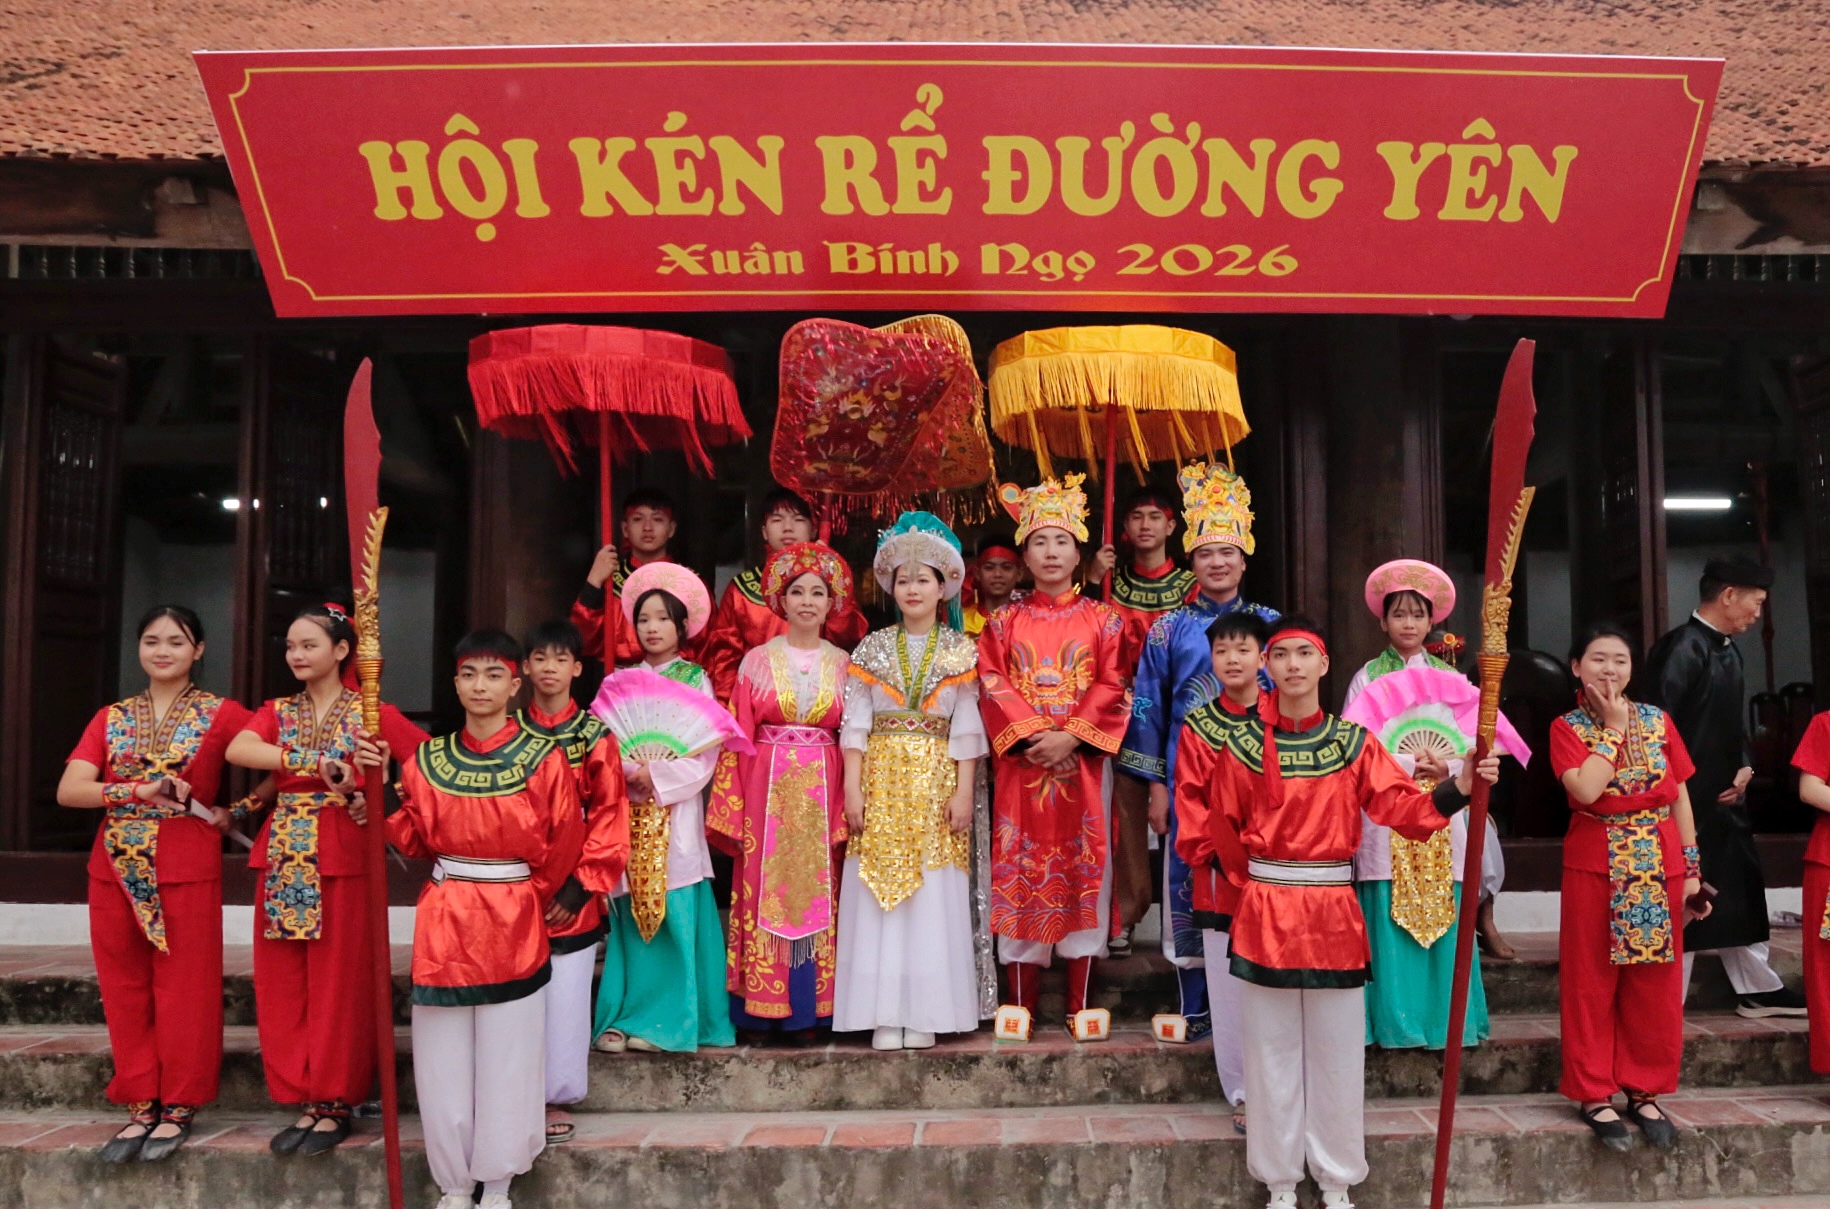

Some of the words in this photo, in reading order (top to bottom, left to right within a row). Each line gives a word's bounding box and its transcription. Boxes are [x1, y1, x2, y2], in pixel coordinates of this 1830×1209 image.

[359, 113, 550, 242] HỘI
[568, 111, 785, 216] KÉN
[815, 83, 953, 216] RỂ
[981, 112, 1344, 219] ĐƯỜNG
[1377, 118, 1578, 222] YÊN
[656, 243, 805, 276] Xuân
[824, 242, 959, 276] Bính
[981, 243, 1096, 281] Ngọ
[1117, 244, 1298, 276] 2026
